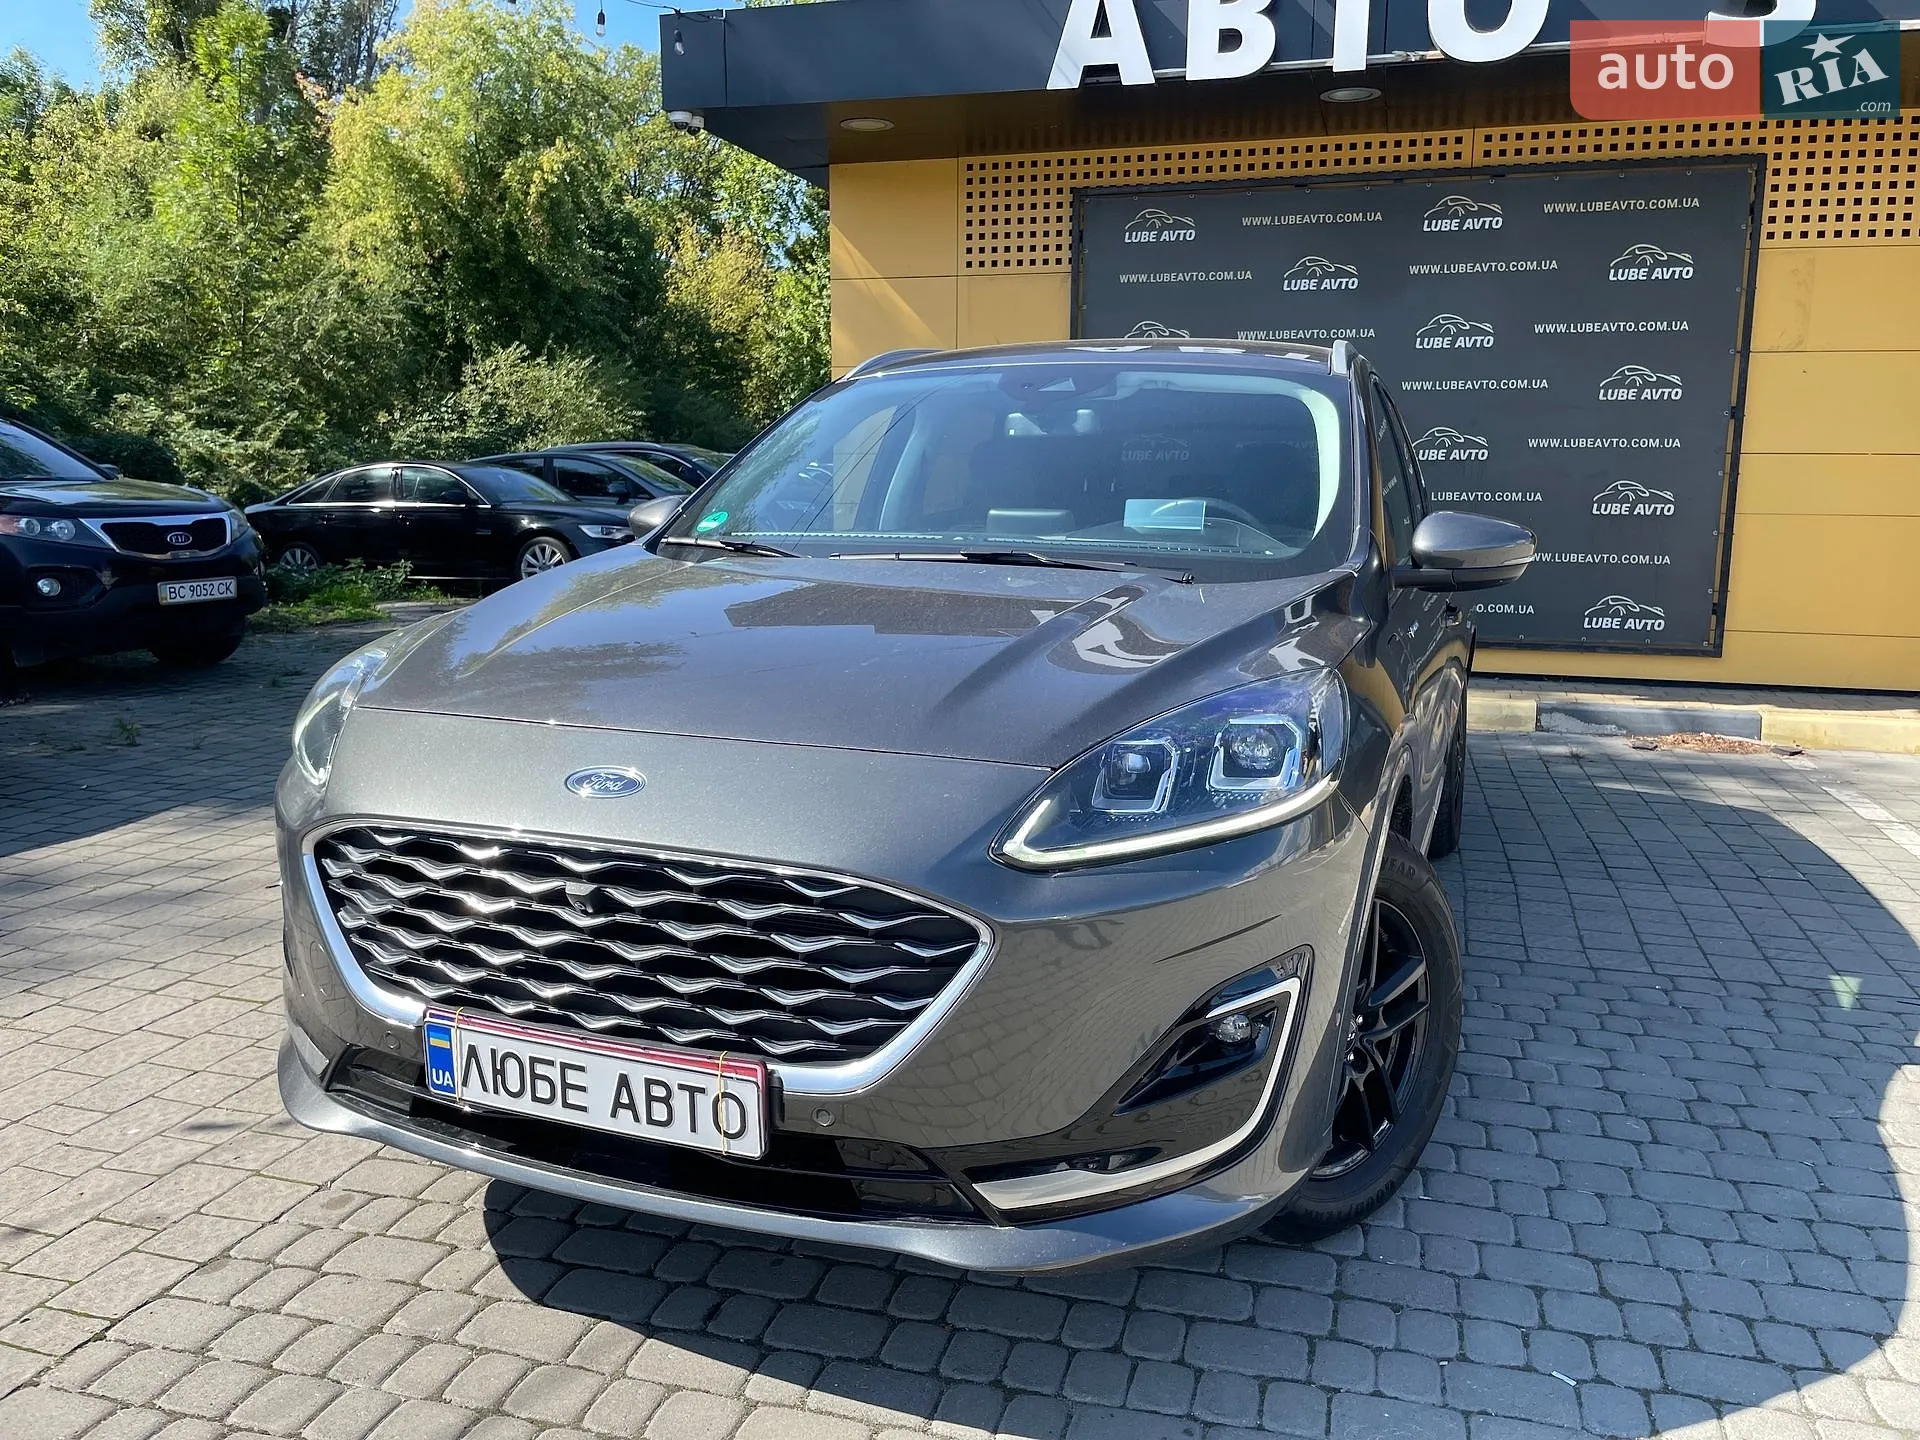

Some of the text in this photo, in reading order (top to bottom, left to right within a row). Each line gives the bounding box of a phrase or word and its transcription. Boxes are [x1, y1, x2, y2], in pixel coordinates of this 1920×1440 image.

[1543, 197, 1700, 214] WWW.LUBEAVTO.COM.UA
[1242, 211, 1383, 226] WWW.LUBEAVTO.COM.UA
[1423, 217, 1503, 232] LUBE AVTO
[1124, 229, 1196, 243] LUBE AVTO
[1409, 260, 1559, 275] WWW.LUBEAVTO.COM.UA
[1608, 266, 1694, 281] LUBE AVTO
[1119, 270, 1253, 283] WWW.LUBEAVTO.COM.UA
[1282, 277, 1359, 291] LUBE AVTO
[1534, 320, 1689, 334] WWW.LUBEAVTO.COM.UA
[1237, 328, 1376, 342] WWW.LUBEAVTO.COM.UA
[1415, 335, 1494, 349] LUBE AVTO
[1401, 379, 1549, 391] WWW.LUBEAVTO.COM.UA
[1598, 388, 1683, 401] LUBE AVTO
[1528, 438, 1681, 449] WWW.LUBEAVTO.COM.UA
[1418, 449, 1489, 461] UBE AVTO
[1591, 503, 1675, 516] LUBE AVTO
[168, 581, 233, 600] BC 9052 CK
[1583, 617, 1665, 631] LUBE AVTO
[582, 773, 628, 791] Ford
[432, 1067, 455, 1088] UA
[461, 1043, 748, 1140] ЛЮБЕ АВТО
